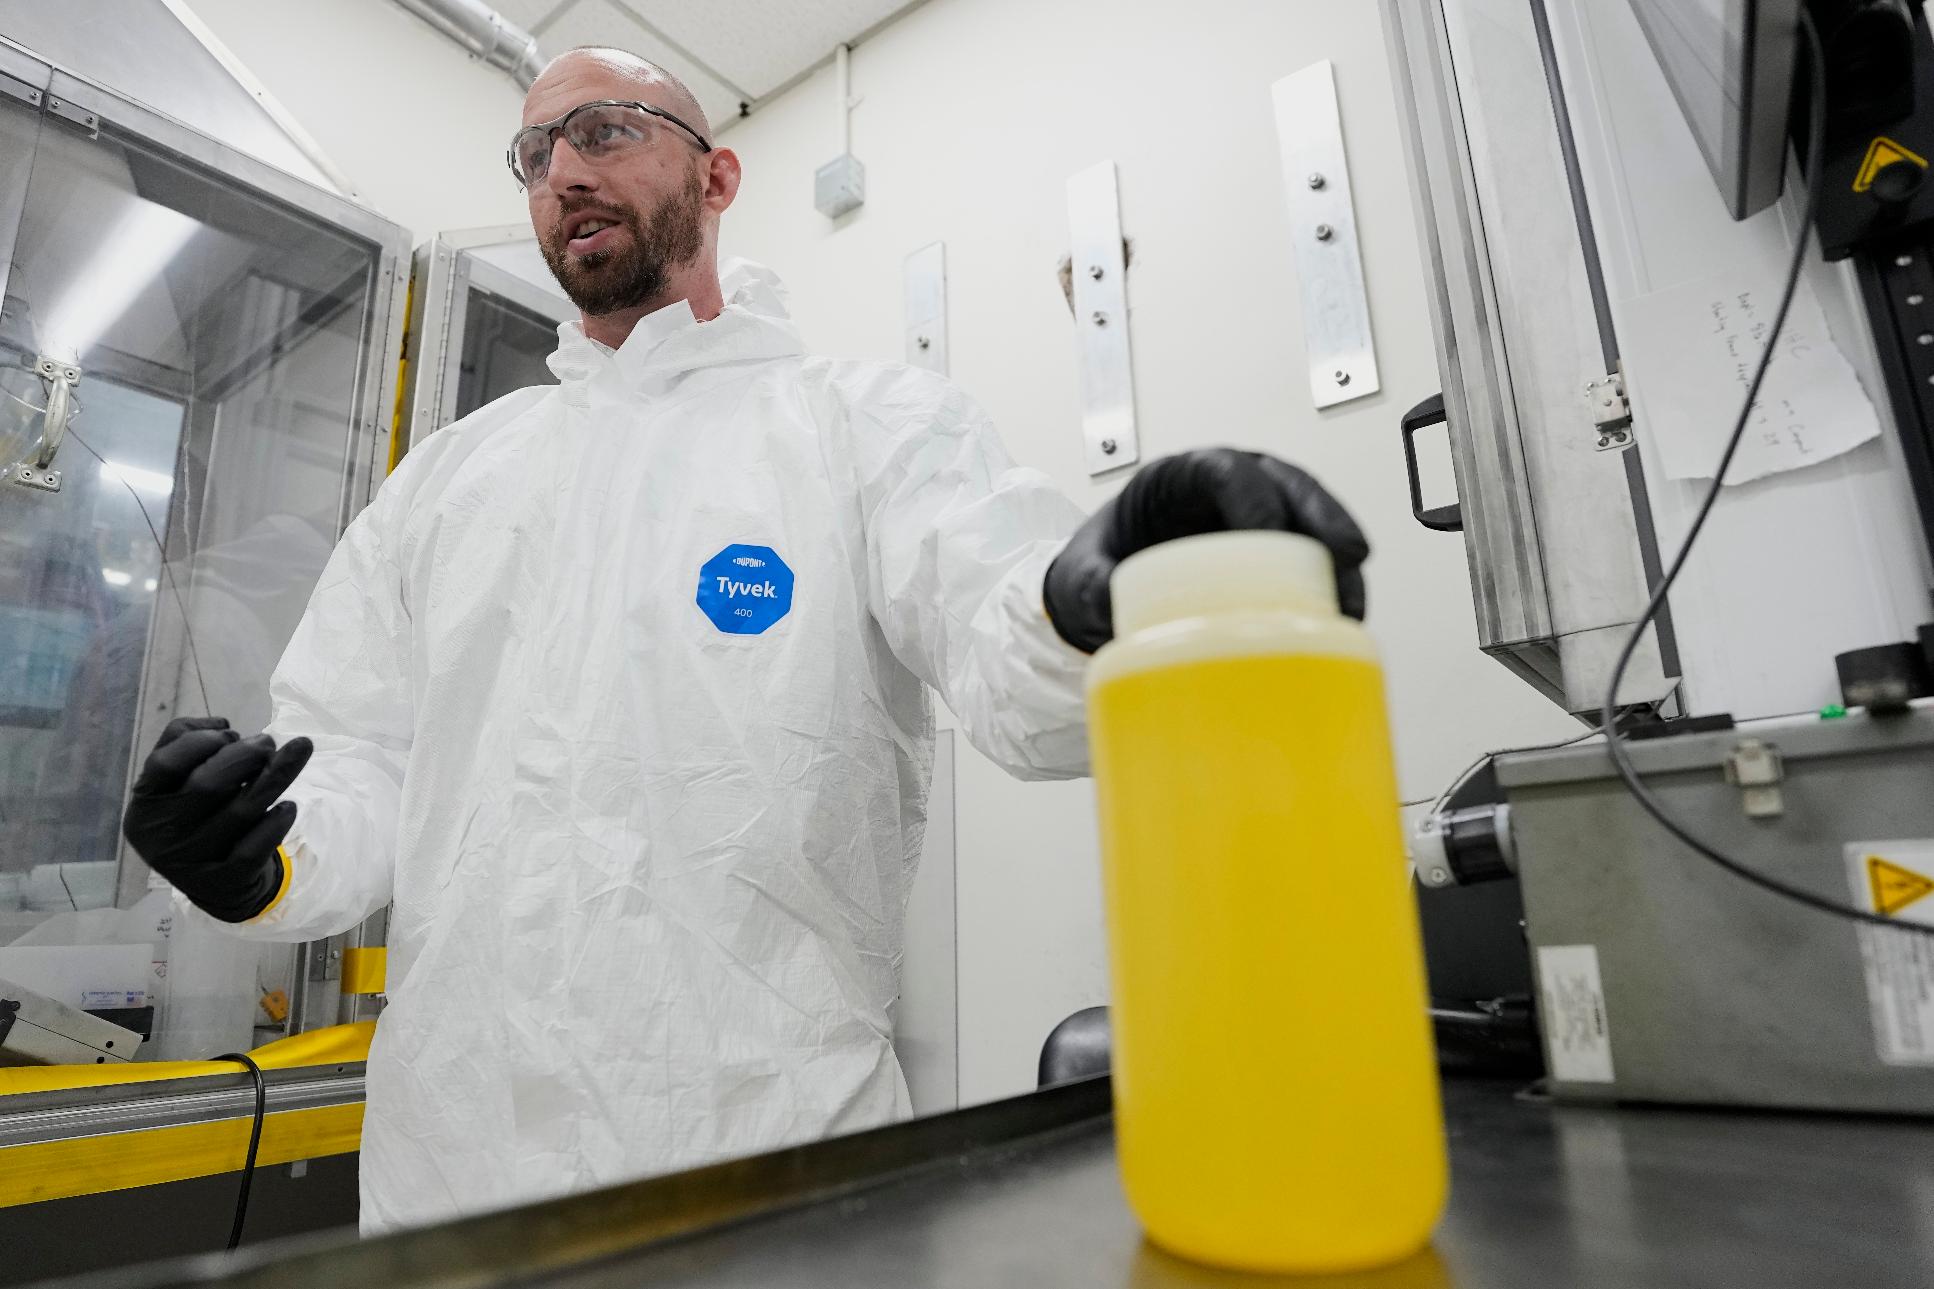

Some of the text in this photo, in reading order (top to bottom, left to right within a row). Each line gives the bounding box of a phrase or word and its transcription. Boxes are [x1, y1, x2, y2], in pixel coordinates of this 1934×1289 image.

[736, 557, 763, 568] DUPONT
[716, 576, 776, 599] Tyvek
[734, 608, 753, 618] 400
